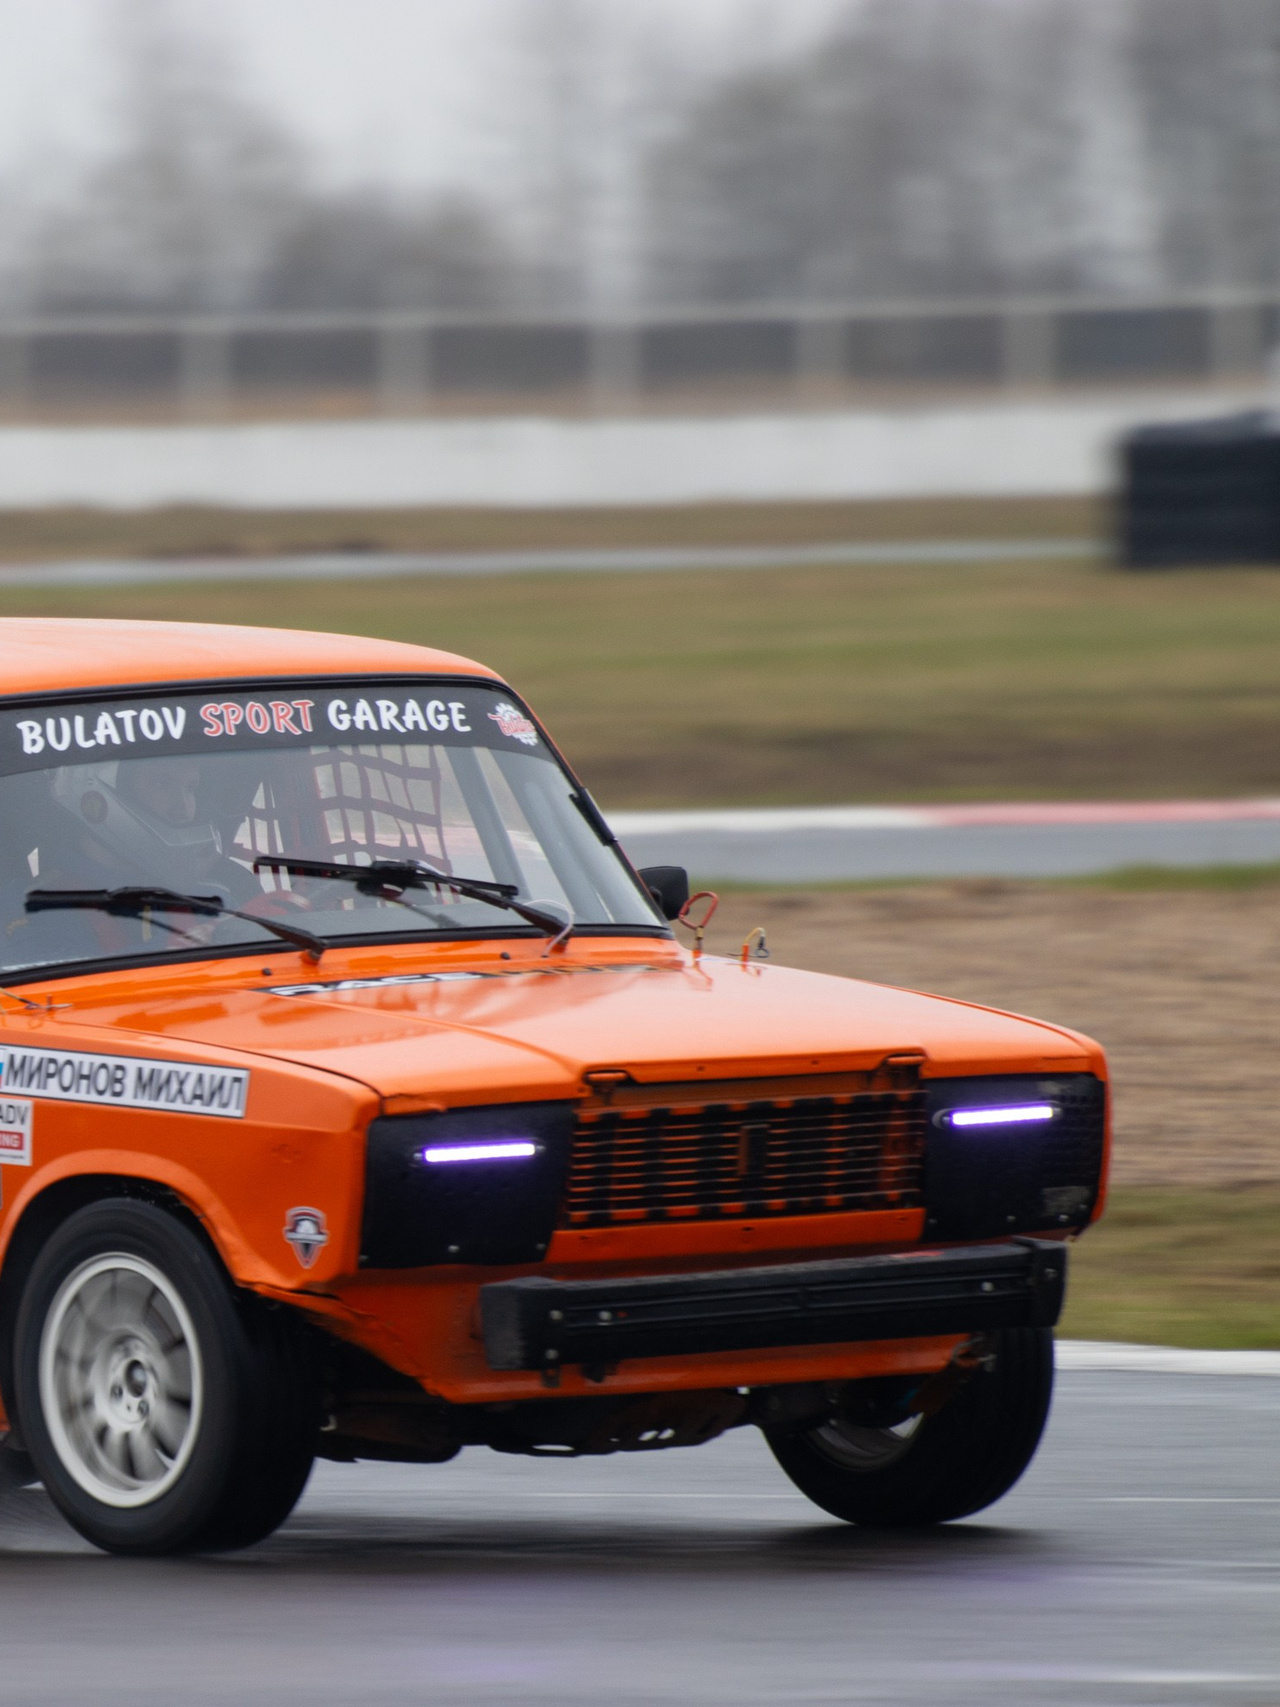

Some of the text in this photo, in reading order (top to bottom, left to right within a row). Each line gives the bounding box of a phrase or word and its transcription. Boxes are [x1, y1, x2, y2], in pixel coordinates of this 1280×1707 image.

[17, 698, 472, 754] BULATOV SPORT GARAGE
[269, 971, 483, 996] RACE
[5, 1053, 244, 1111] МИРОНОВ МИХАИЛ
